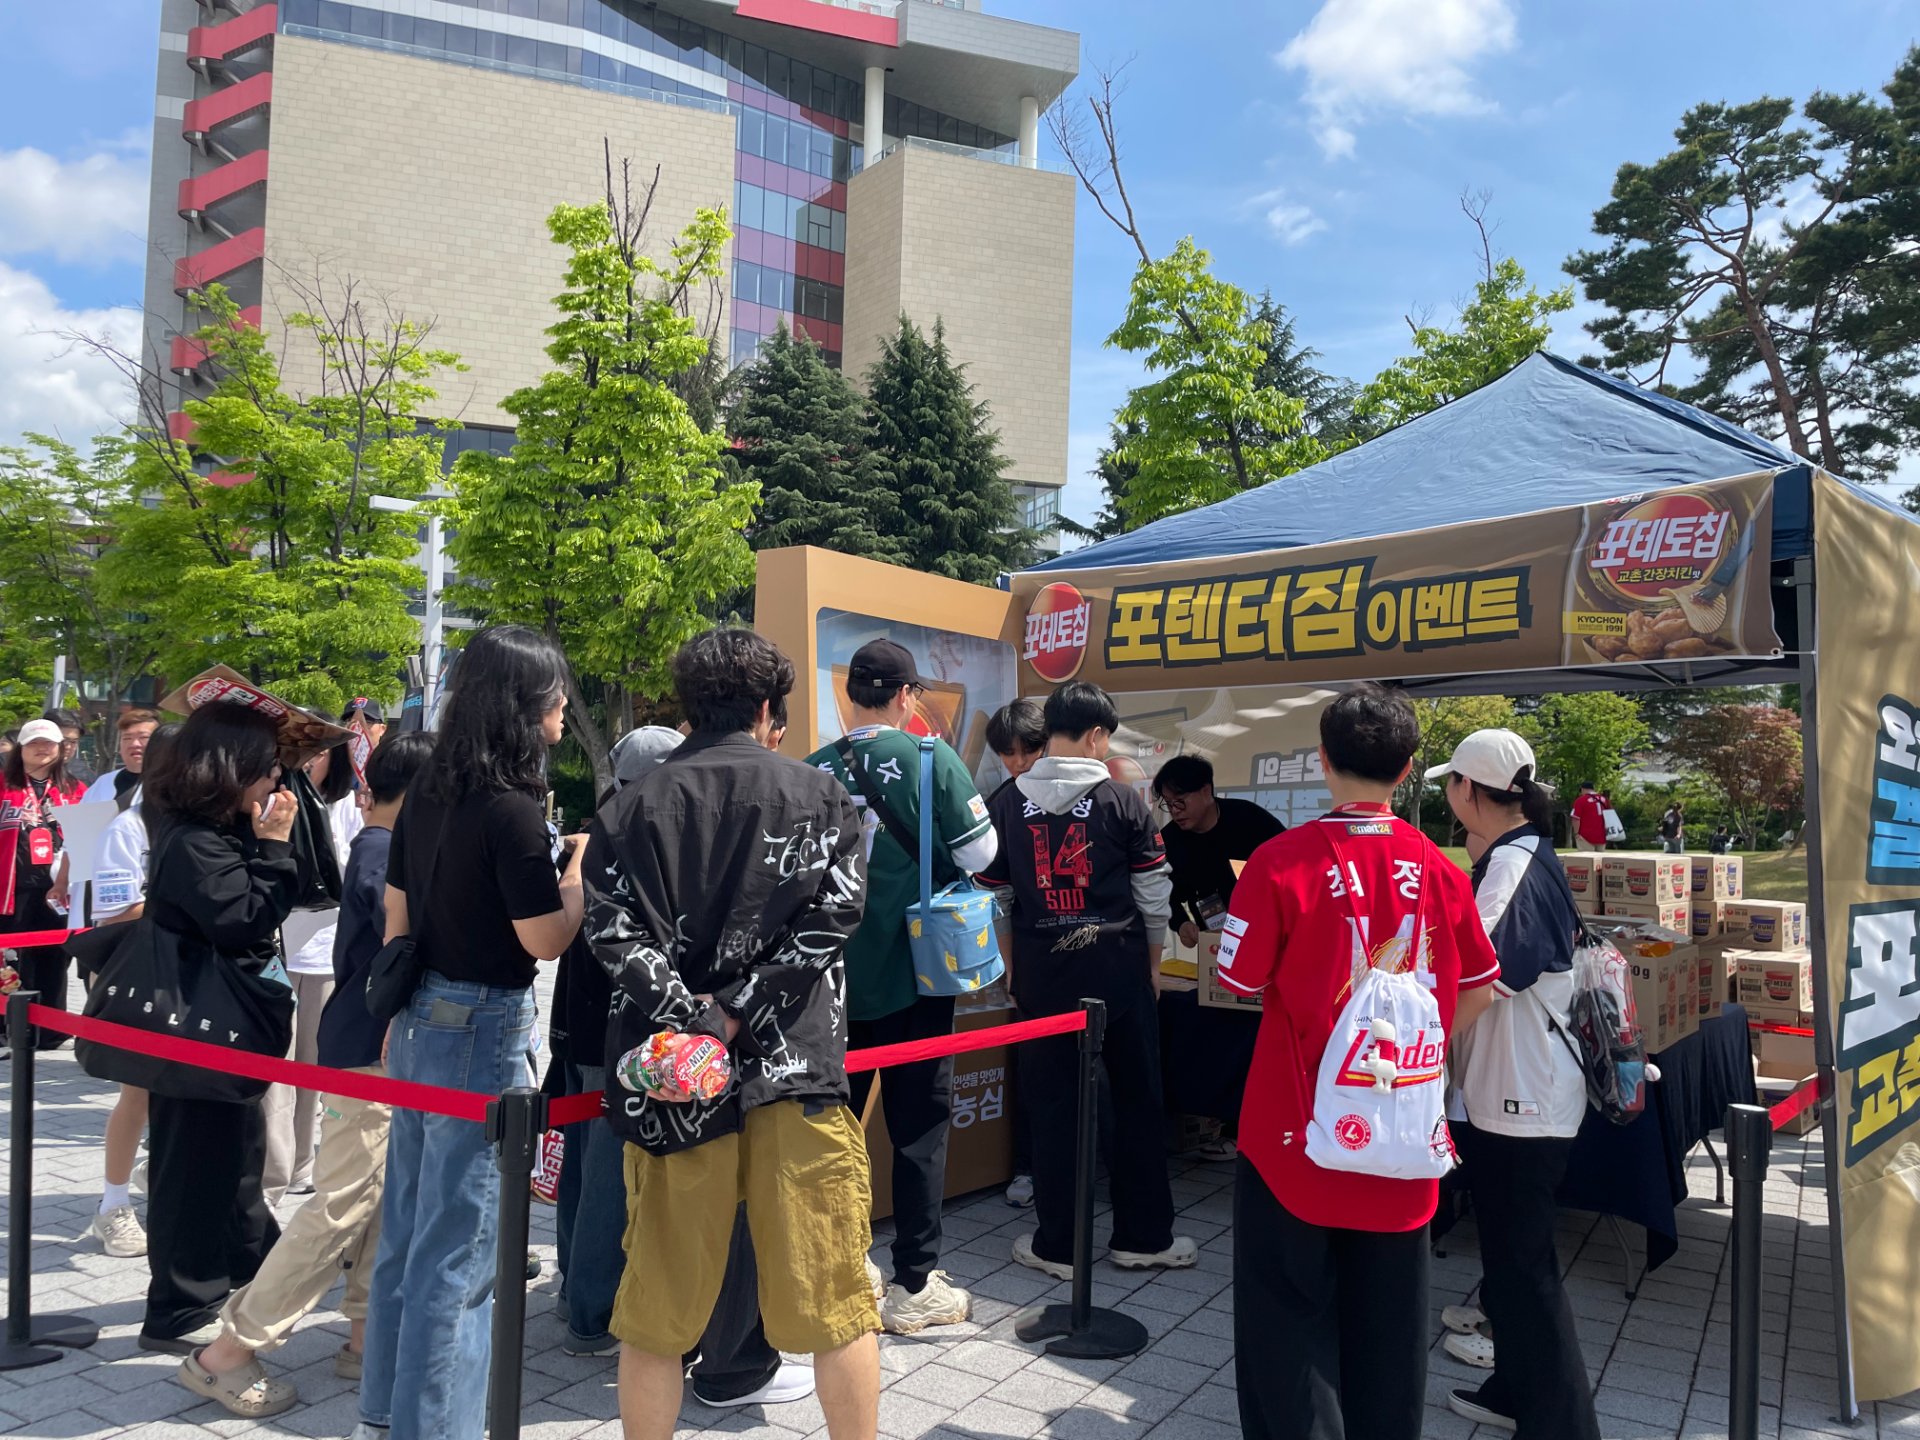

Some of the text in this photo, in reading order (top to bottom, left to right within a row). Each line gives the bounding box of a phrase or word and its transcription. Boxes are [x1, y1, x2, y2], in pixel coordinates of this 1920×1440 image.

[1591, 511, 1730, 568] 포테토칩
[1617, 570, 1642, 583] 교촌
[1109, 565, 1521, 663] 포텐터짐 이벤트
[1577, 615, 1623, 625] KYOCHON
[1023, 602, 1091, 661] 포테토칩
[1605, 625, 1623, 633] 1991
[1350, 824, 1390, 834] emart24
[1027, 823, 1093, 888] 14
[1045, 888, 1086, 910] 500
[688, 1040, 714, 1068] MIRA
[951, 1085, 1004, 1129] 농심
